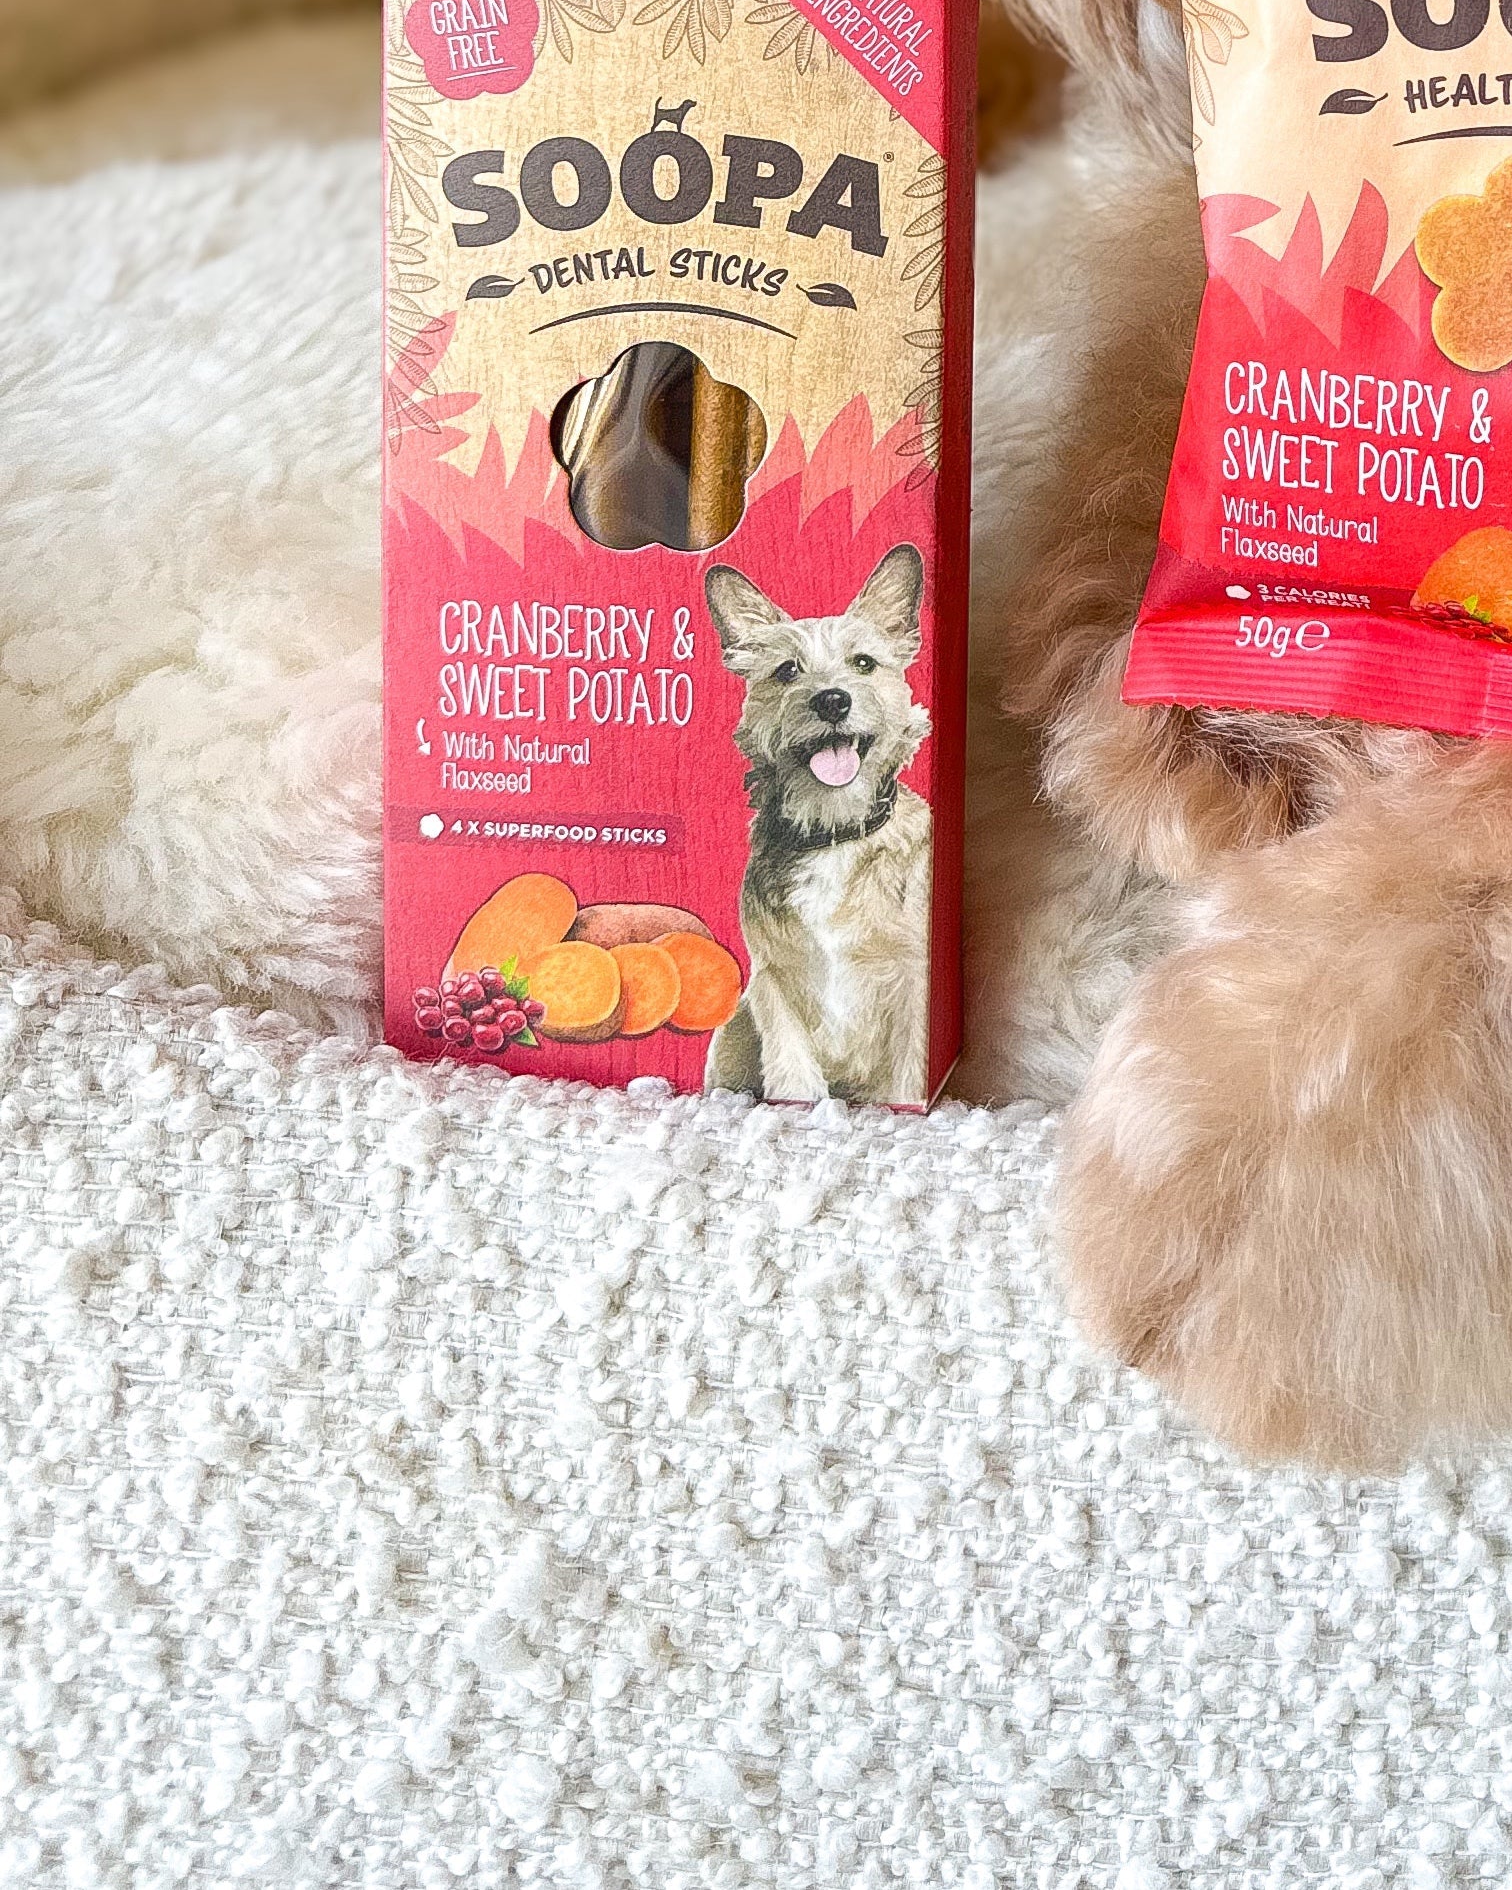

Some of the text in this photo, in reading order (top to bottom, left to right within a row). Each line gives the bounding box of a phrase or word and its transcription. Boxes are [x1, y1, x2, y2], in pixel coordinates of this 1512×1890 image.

[446, 30, 505, 71] FREE
[441, 129, 890, 258] SOOPA
[528, 246, 789, 297] DENTAL STICKS
[1224, 360, 1494, 444] CRANBERRY &
[1222, 425, 1485, 510] SWEET POTATO
[1221, 494, 1379, 544] With Natural
[1221, 527, 1319, 567] Flaxseed
[1256, 583, 1372, 604] 3 CALORIES
[1260, 594, 1300, 604] PER
[439, 600, 695, 662] CRANBERRY &
[439, 661, 694, 727] SWEET POTATO
[442, 730, 591, 766] With Natural
[441, 761, 532, 794] Flaxseed
[450, 819, 667, 845] 4 X SUPERFOOD STICKS
